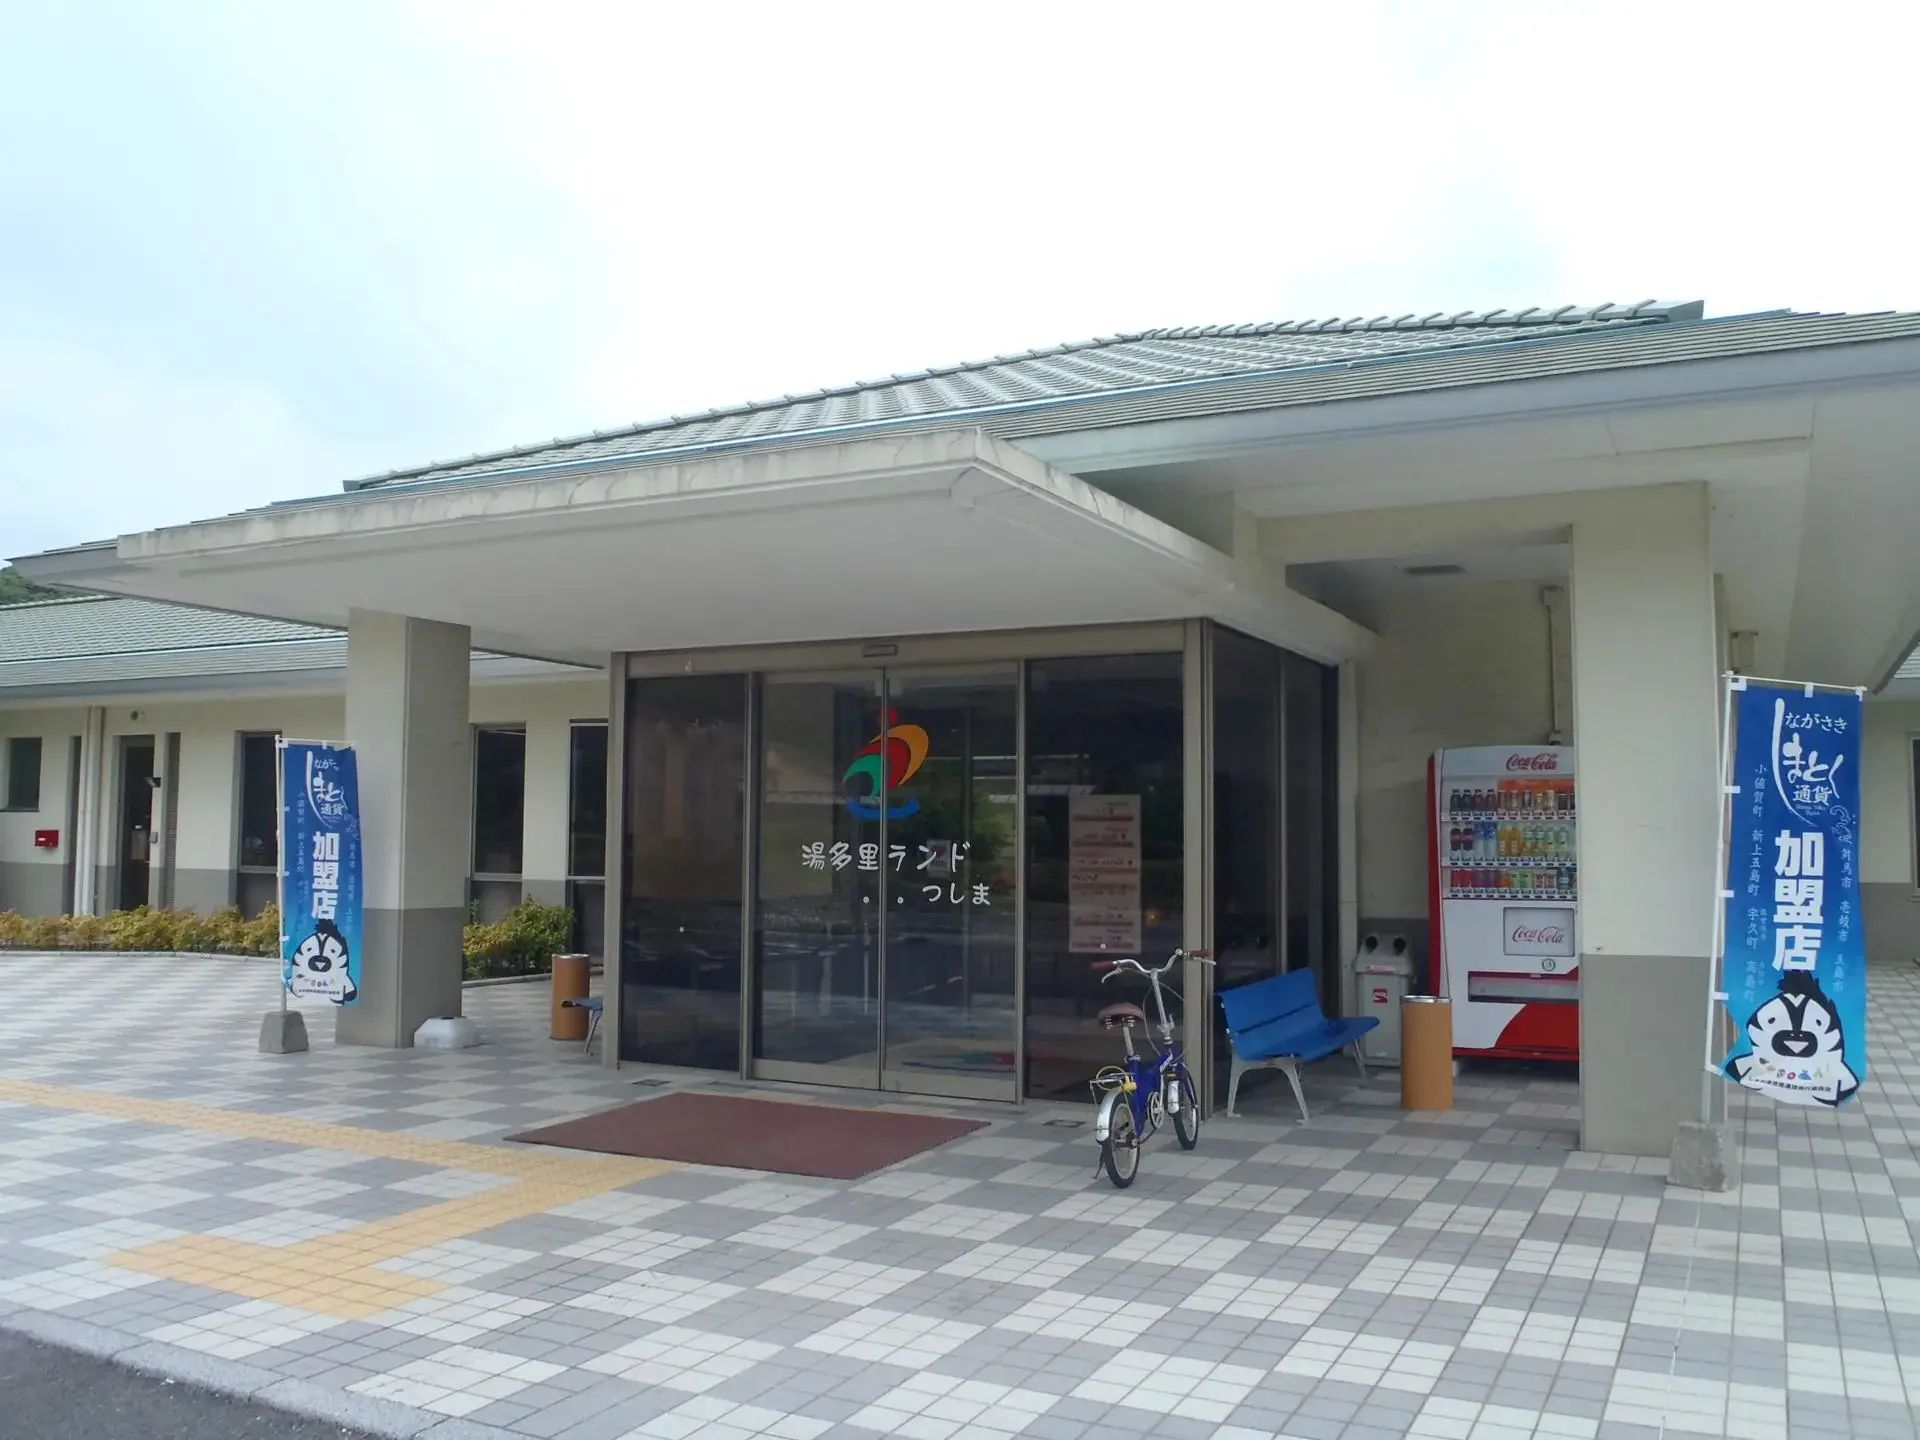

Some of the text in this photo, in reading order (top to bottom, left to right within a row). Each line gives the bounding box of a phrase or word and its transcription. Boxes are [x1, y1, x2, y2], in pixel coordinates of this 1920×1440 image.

[1785, 712, 1847, 734] ながさき
[1792, 785, 1832, 806] 通貨
[801, 841, 971, 873] 湯多里ランド
[311, 831, 340, 920] 加盟店
[922, 882, 991, 906] つしま
[1771, 829, 1825, 971] 加盟店
